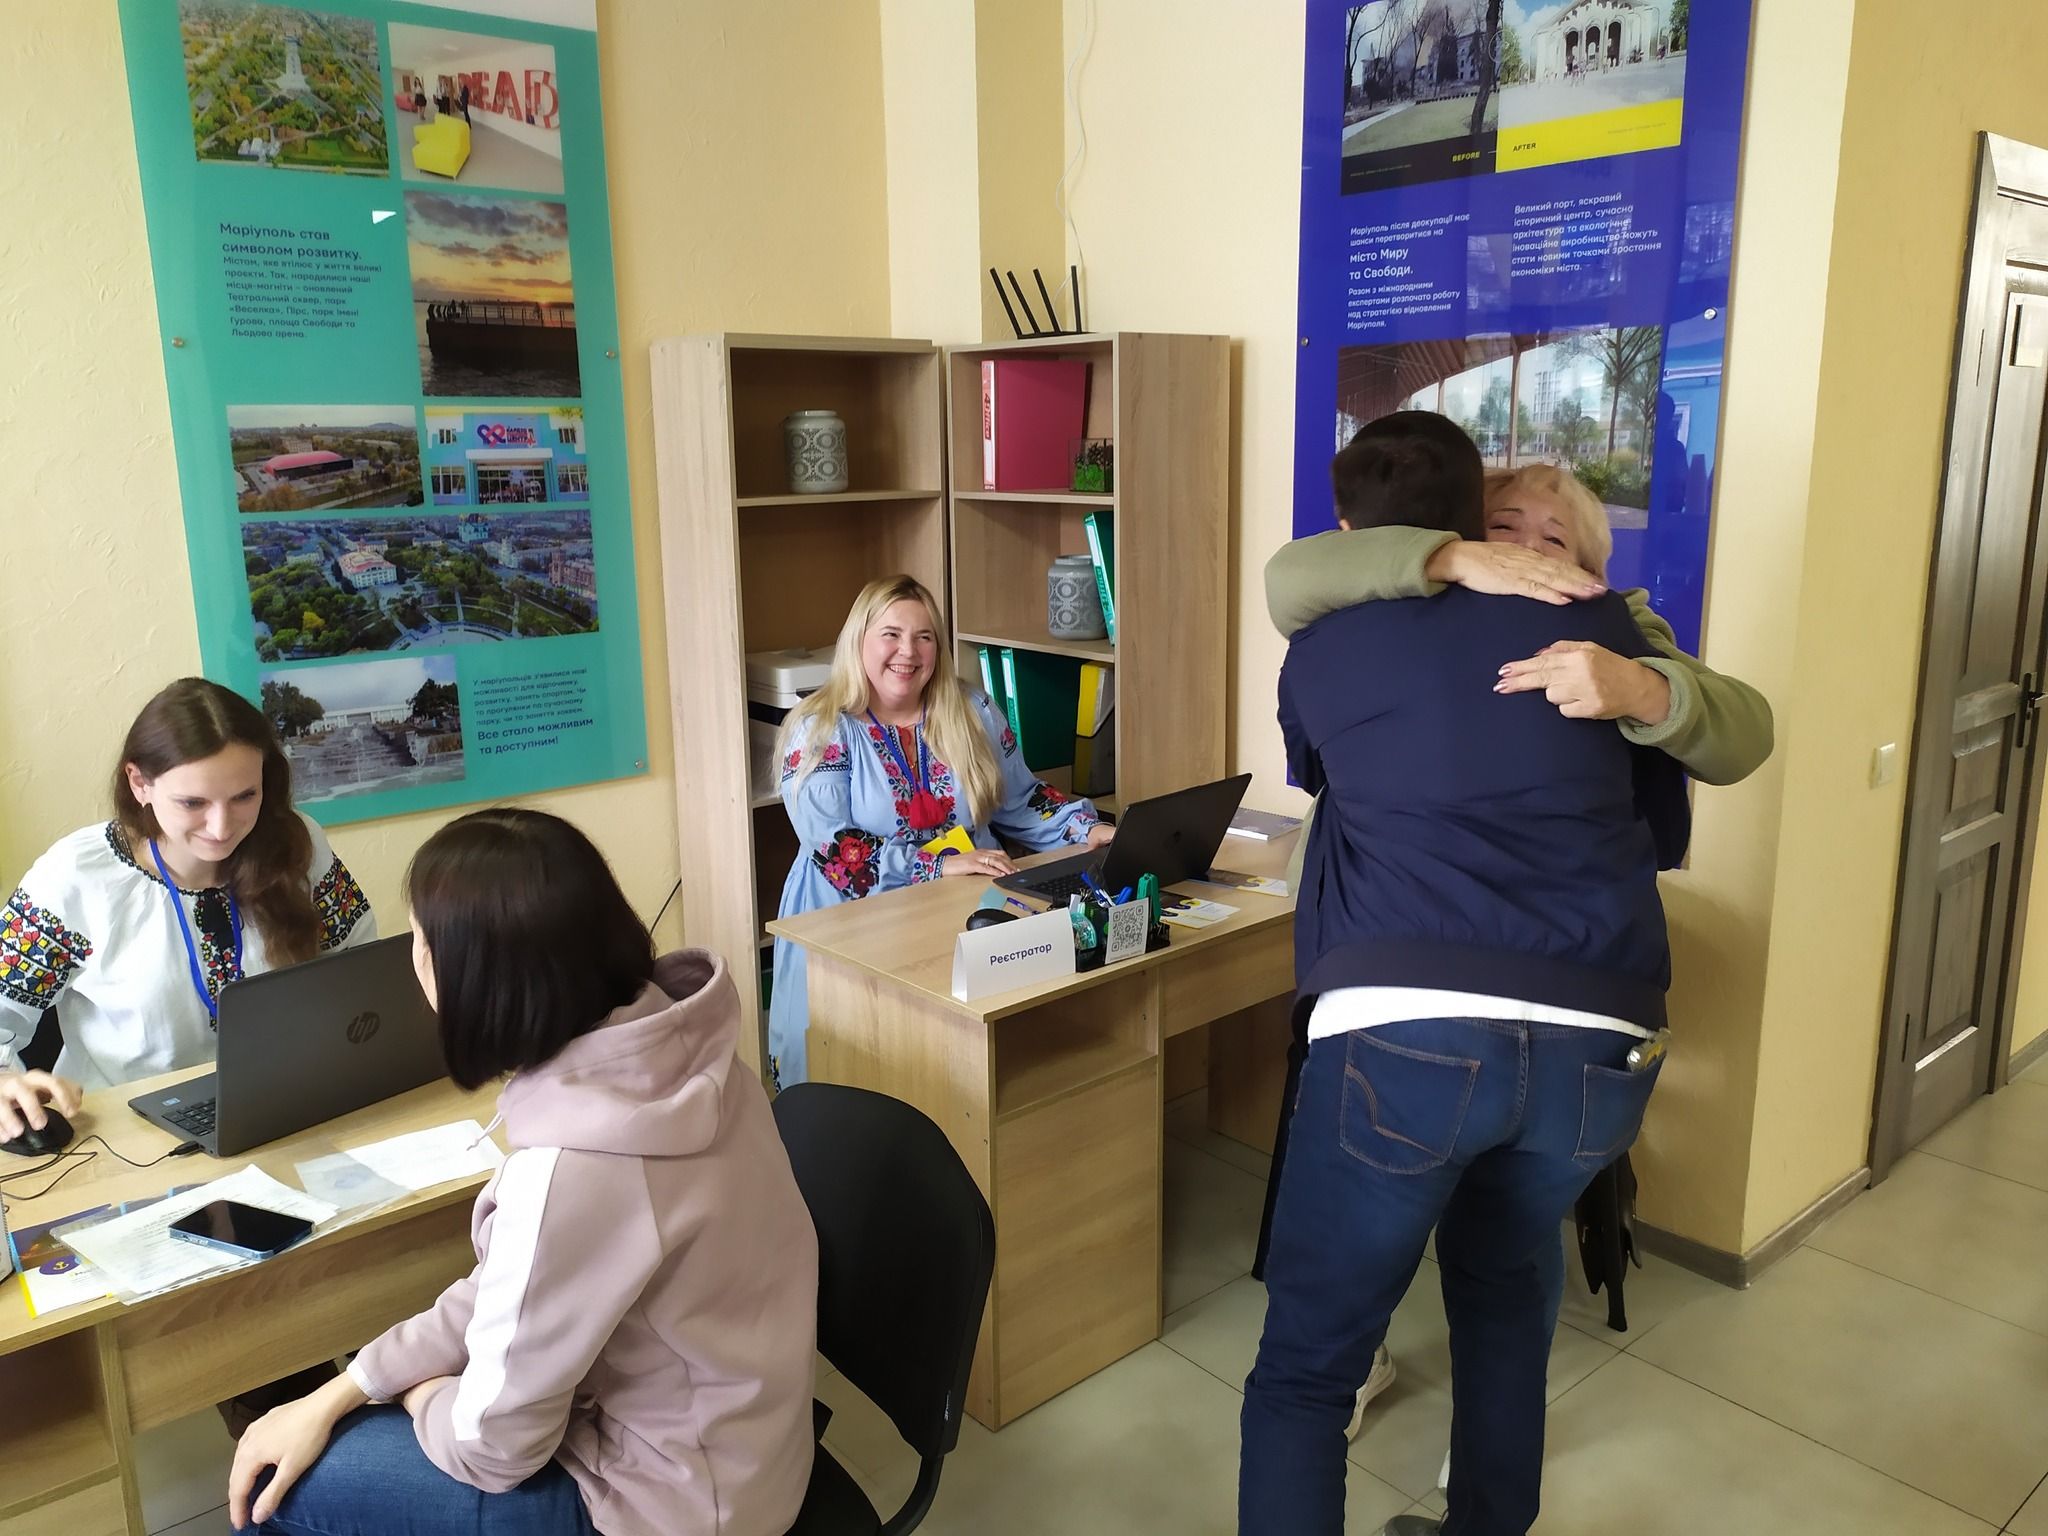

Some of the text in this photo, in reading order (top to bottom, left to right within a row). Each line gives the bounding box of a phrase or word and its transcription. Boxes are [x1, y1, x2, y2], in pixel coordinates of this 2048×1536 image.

[1513, 142, 1536, 152] AFTER
[1452, 151, 1480, 163] BEFORE
[1514, 192, 1622, 214] Великий порт, яскравий
[1514, 205, 1634, 227] історичний центр, сучасна
[220, 223, 330, 240] Маріуполь став
[1350, 213, 1470, 237] Маріуполь після деокупації має
[1513, 225, 1565, 240] архітектура
[1567, 225, 1577, 233] та
[1350, 228, 1443, 246] шанси перетворитися на
[1561, 233, 1621, 248] виробництво
[1622, 229, 1658, 241] можуть
[222, 243, 362, 261] символом розвитку.
[1350, 247, 1409, 263] місто Миру
[1512, 241, 1662, 265] стати новими точками зростання
[224, 256, 260, 267] Містом,
[1511, 262, 1582, 278] економіки міста.
[1349, 265, 1413, 280] та Свободи.
[1348, 287, 1370, 296] Разом
[1378, 281, 1433, 293] міжнародними
[1348, 290, 1460, 309] експертами розпочато роботу
[1347, 302, 1451, 319] над стратегією відновлення
[302, 318, 343, 328] Свободи
[1347, 319, 1387, 331] Маріуполя.
[232, 328, 273, 338] Льодова
[477, 718, 594, 741] Все стало можливим
[480, 735, 559, 755] та доступним!
[990, 943, 1052, 966] Реєстратор
